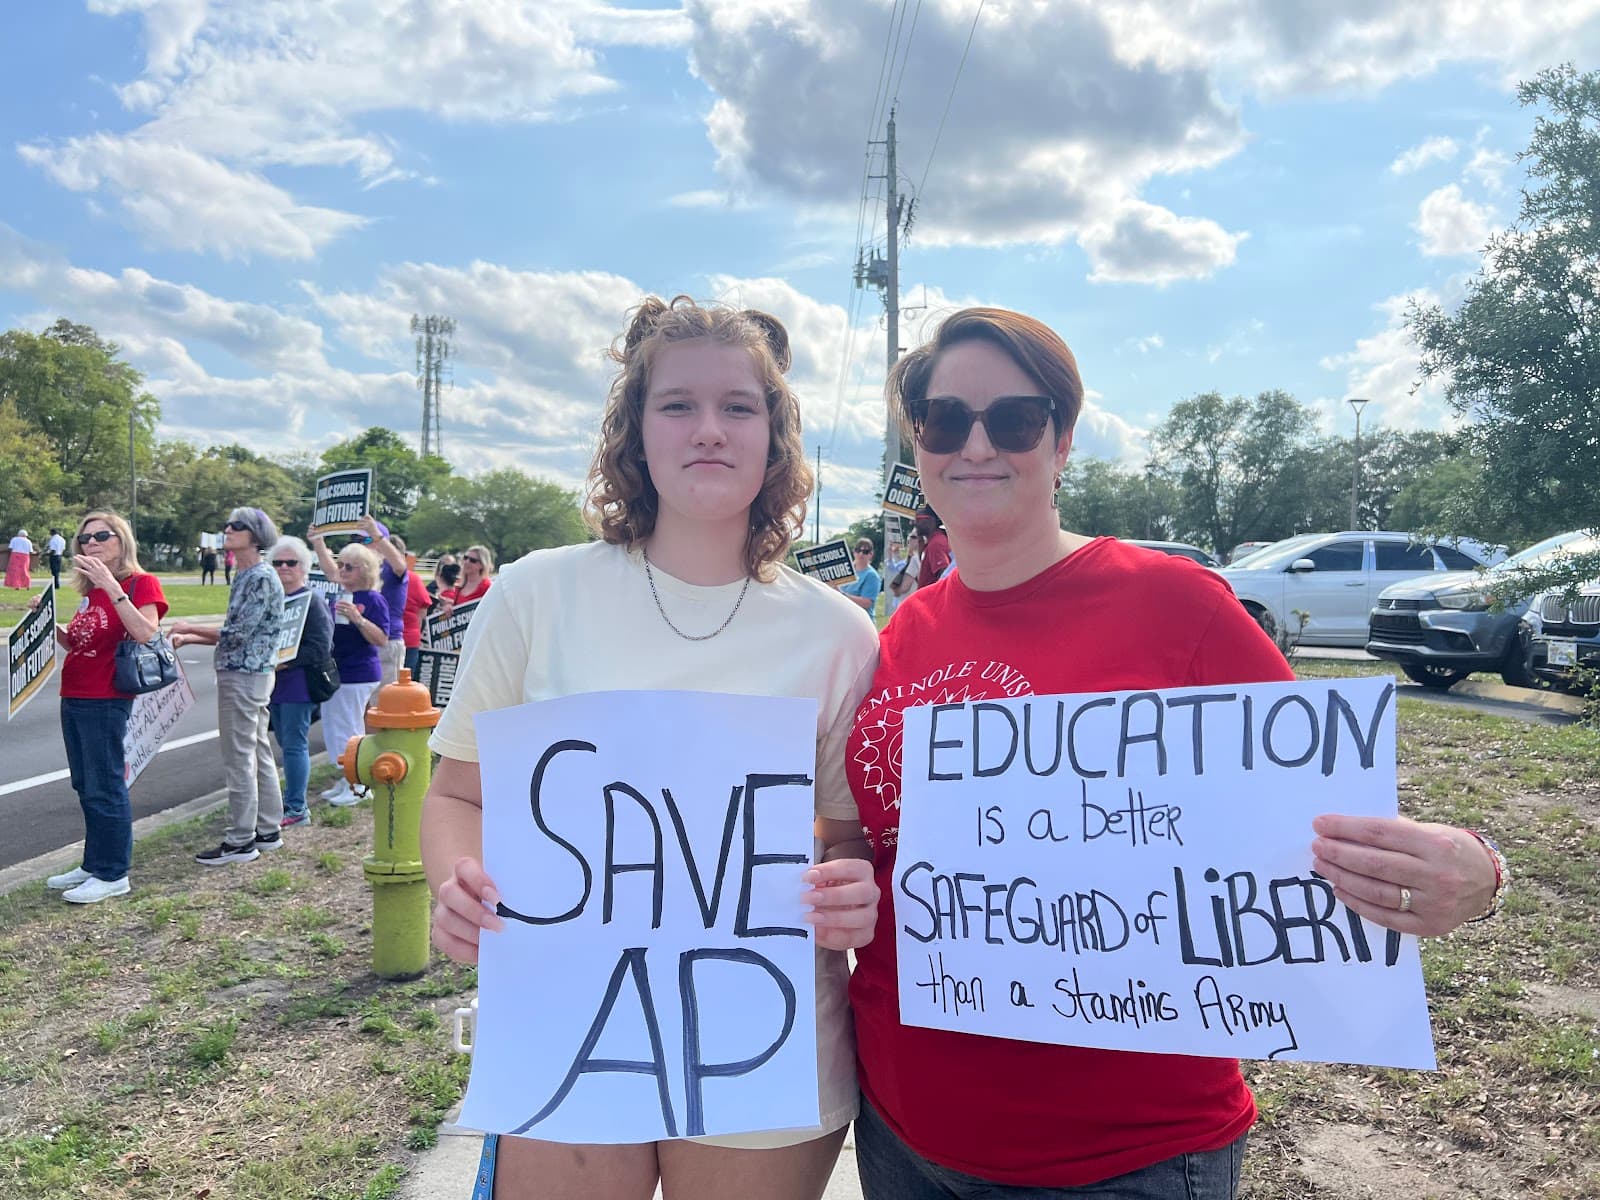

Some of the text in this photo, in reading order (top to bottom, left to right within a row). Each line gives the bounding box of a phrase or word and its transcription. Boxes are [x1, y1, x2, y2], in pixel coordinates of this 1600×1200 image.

[327, 502, 363, 523] FUTURE
[333, 481, 365, 497] SCHOOLS
[888, 488, 912, 508] OUR
[11, 628, 30, 664] PUBLIC
[30, 600, 52, 643] SCHOOLS
[431, 617, 456, 636] PUBLIC
[12, 630, 54, 698] OUR FUTURE
[435, 656, 457, 705] FUTURE
[928, 682, 1396, 781] EDUCATION
[496, 740, 813, 939] SAVE
[900, 861, 1130, 955] SAFEGUARD
[1134, 890, 1168, 945] of
[916, 952, 985, 1016] than
[1010, 979, 1034, 1008] a
[508, 947, 797, 1137] AP
